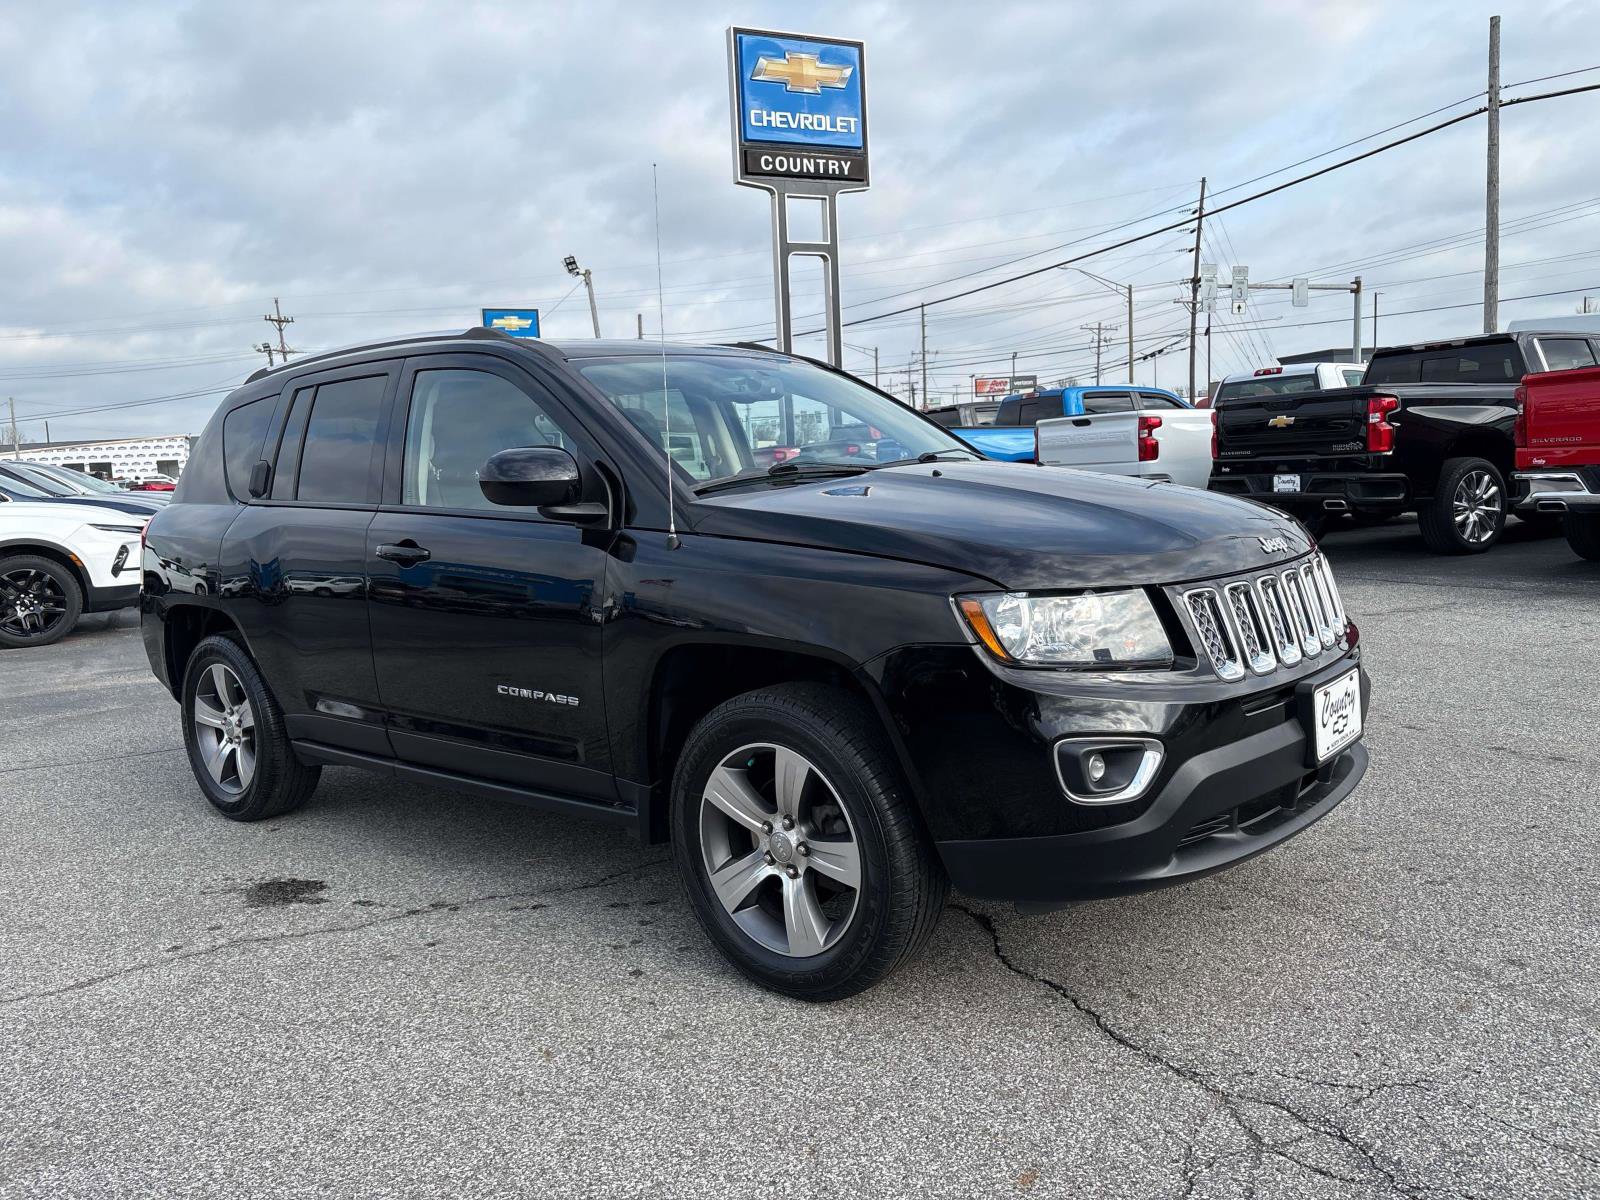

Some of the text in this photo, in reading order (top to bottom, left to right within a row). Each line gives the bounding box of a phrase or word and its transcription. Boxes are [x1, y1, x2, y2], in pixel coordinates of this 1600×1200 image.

[751, 110, 857, 132] CHEVROLET
[761, 155, 850, 175] COUNTRY
[1258, 537, 1288, 553] Jeep
[497, 685, 579, 706] COMPASS
[1322, 686, 1355, 728] Country
